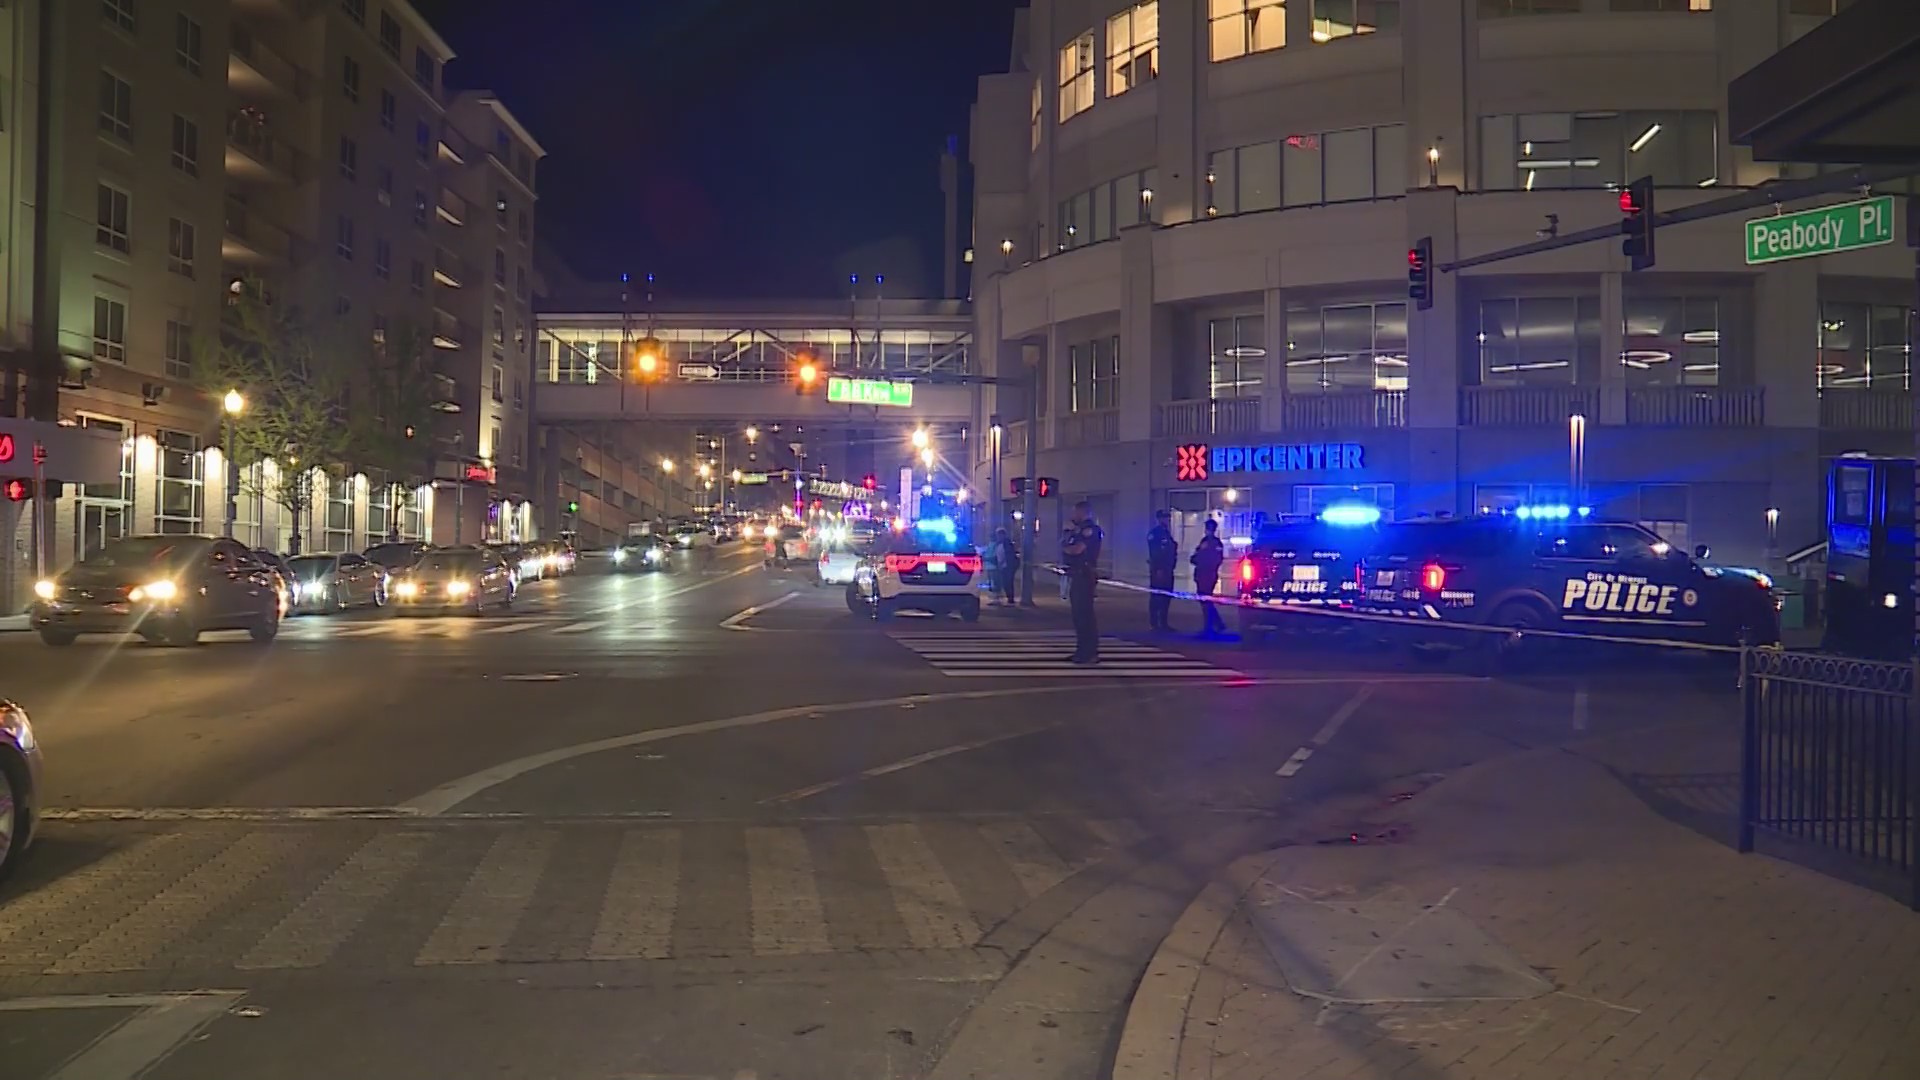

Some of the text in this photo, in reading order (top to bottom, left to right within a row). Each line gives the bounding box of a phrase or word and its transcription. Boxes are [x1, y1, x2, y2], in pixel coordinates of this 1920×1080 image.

[1753, 204, 1888, 256] Peabody Pl.
[1211, 443, 1365, 473] EPICENTER
[1282, 581, 1328, 593] POLICE
[1562, 578, 1678, 615] POLICE
